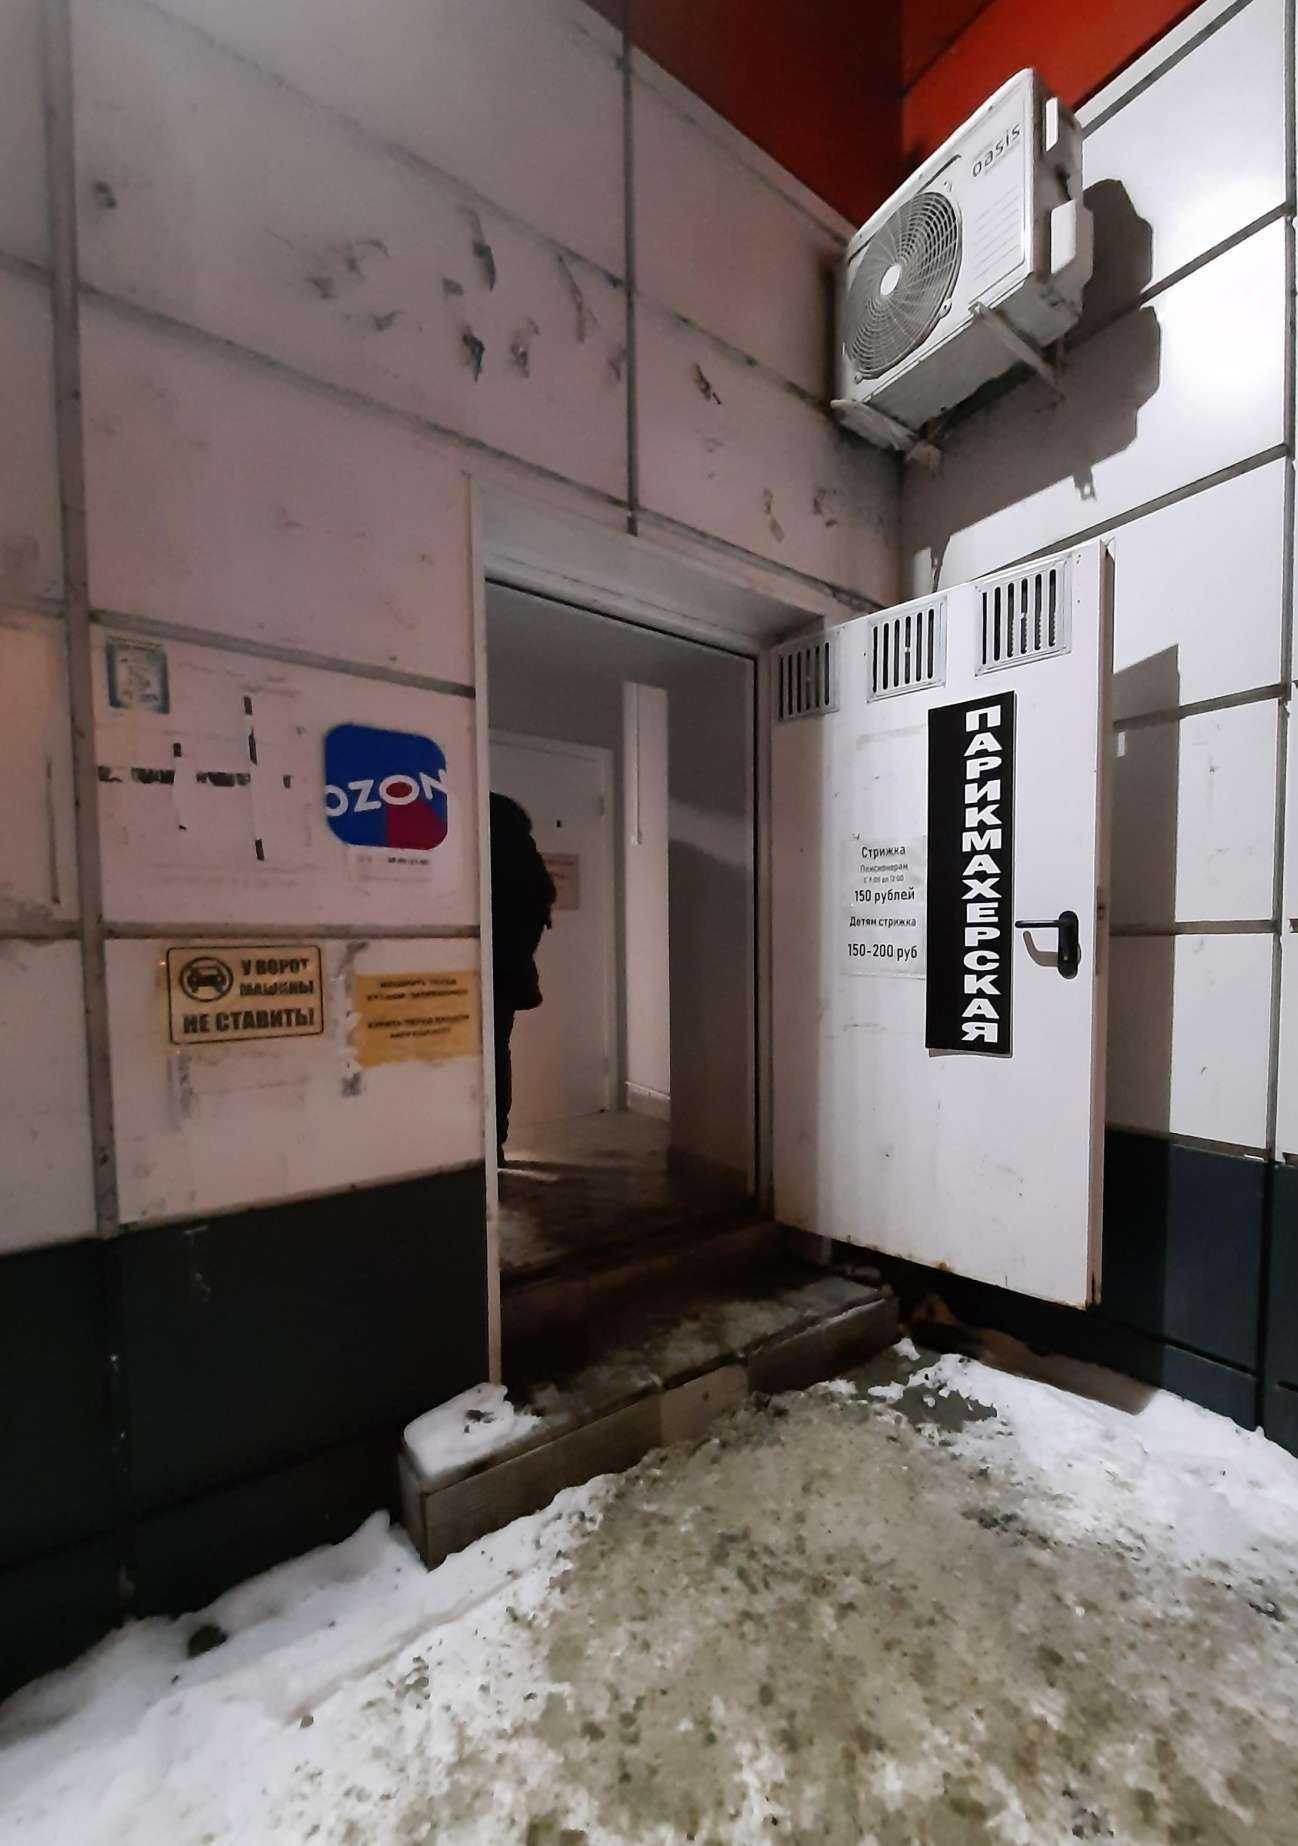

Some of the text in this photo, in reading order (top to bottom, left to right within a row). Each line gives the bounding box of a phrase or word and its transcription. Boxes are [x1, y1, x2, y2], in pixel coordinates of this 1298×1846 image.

[972, 124, 1020, 177] oasis
[324, 769, 448, 817] OZON
[861, 846, 906, 860] Стрижка
[960, 706, 1003, 1043] ПАРИКМАХЕРСКАЯ
[855, 887, 915, 904] 150 рублей
[879, 917, 917, 928] стрижка
[848, 944, 918, 961] 150-200 руб
[241, 958, 309, 976] У ВОРОТ
[183, 1014, 210, 1034] НЕ
